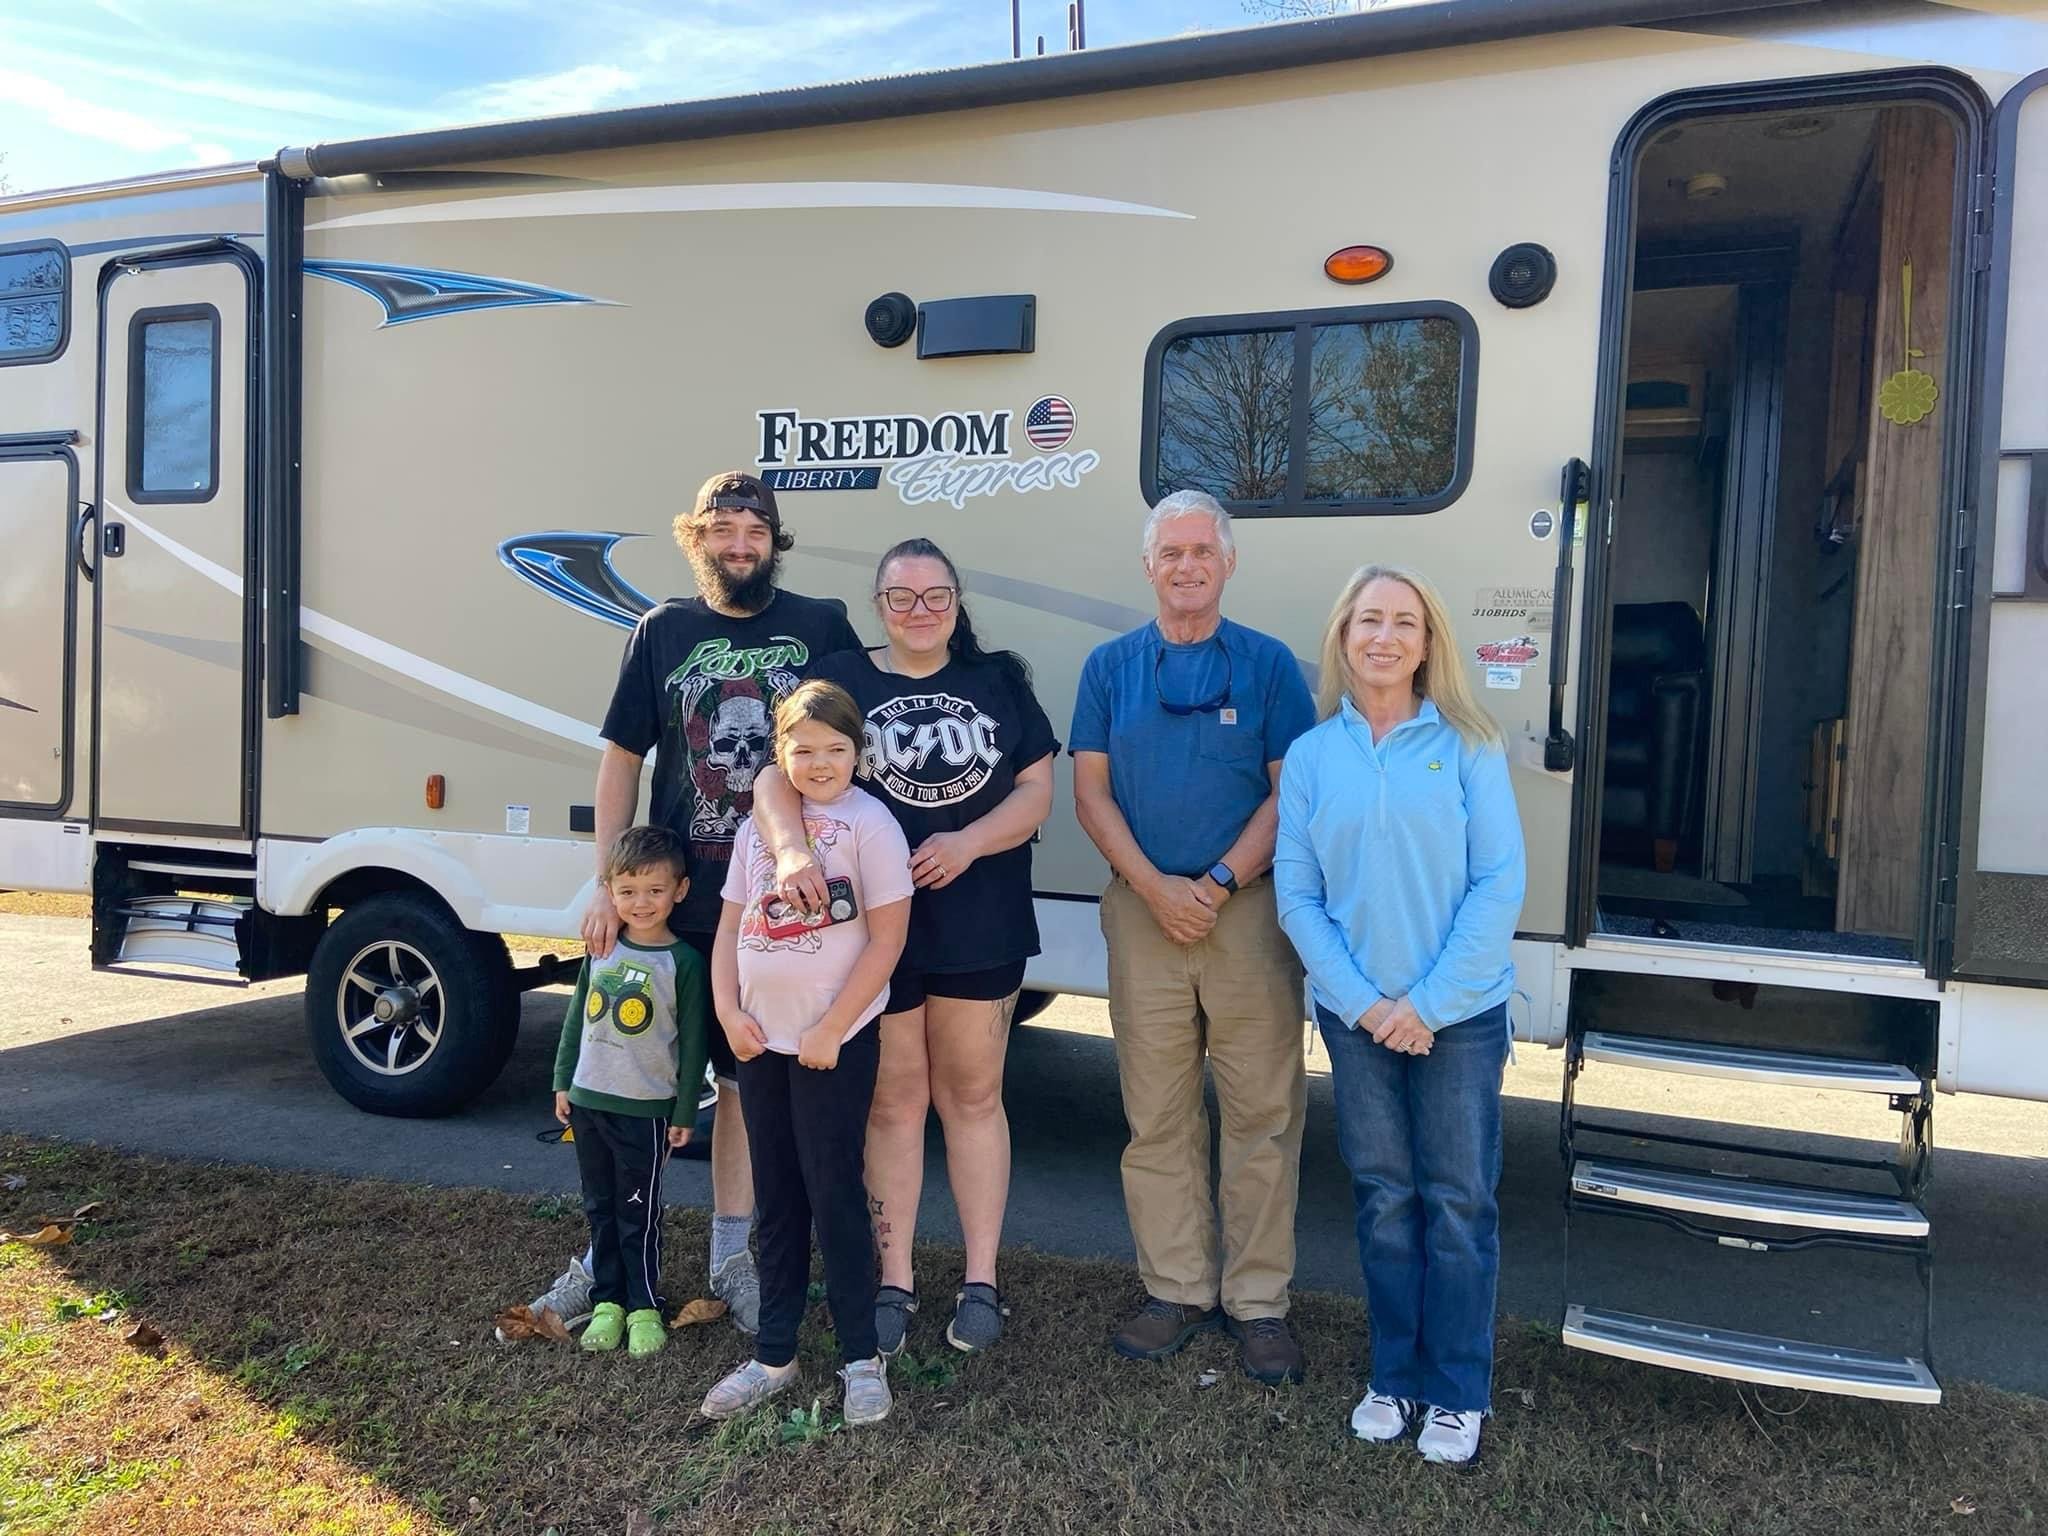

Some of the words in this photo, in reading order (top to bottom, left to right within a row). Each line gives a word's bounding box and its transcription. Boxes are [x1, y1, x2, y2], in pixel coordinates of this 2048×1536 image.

[757, 411, 1009, 463] FREEDOM
[774, 469, 864, 489] LIBERTY
[888, 451, 1098, 507] Express
[1492, 587, 1554, 600] ALUMICAG
[1471, 608, 1527, 617] 310BHDS
[880, 699, 908, 719] BACK
[914, 698, 927, 709] IN
[932, 697, 965, 714] BLACK
[886, 774, 914, 799] WORLD
[917, 787, 939, 801] TOUR
